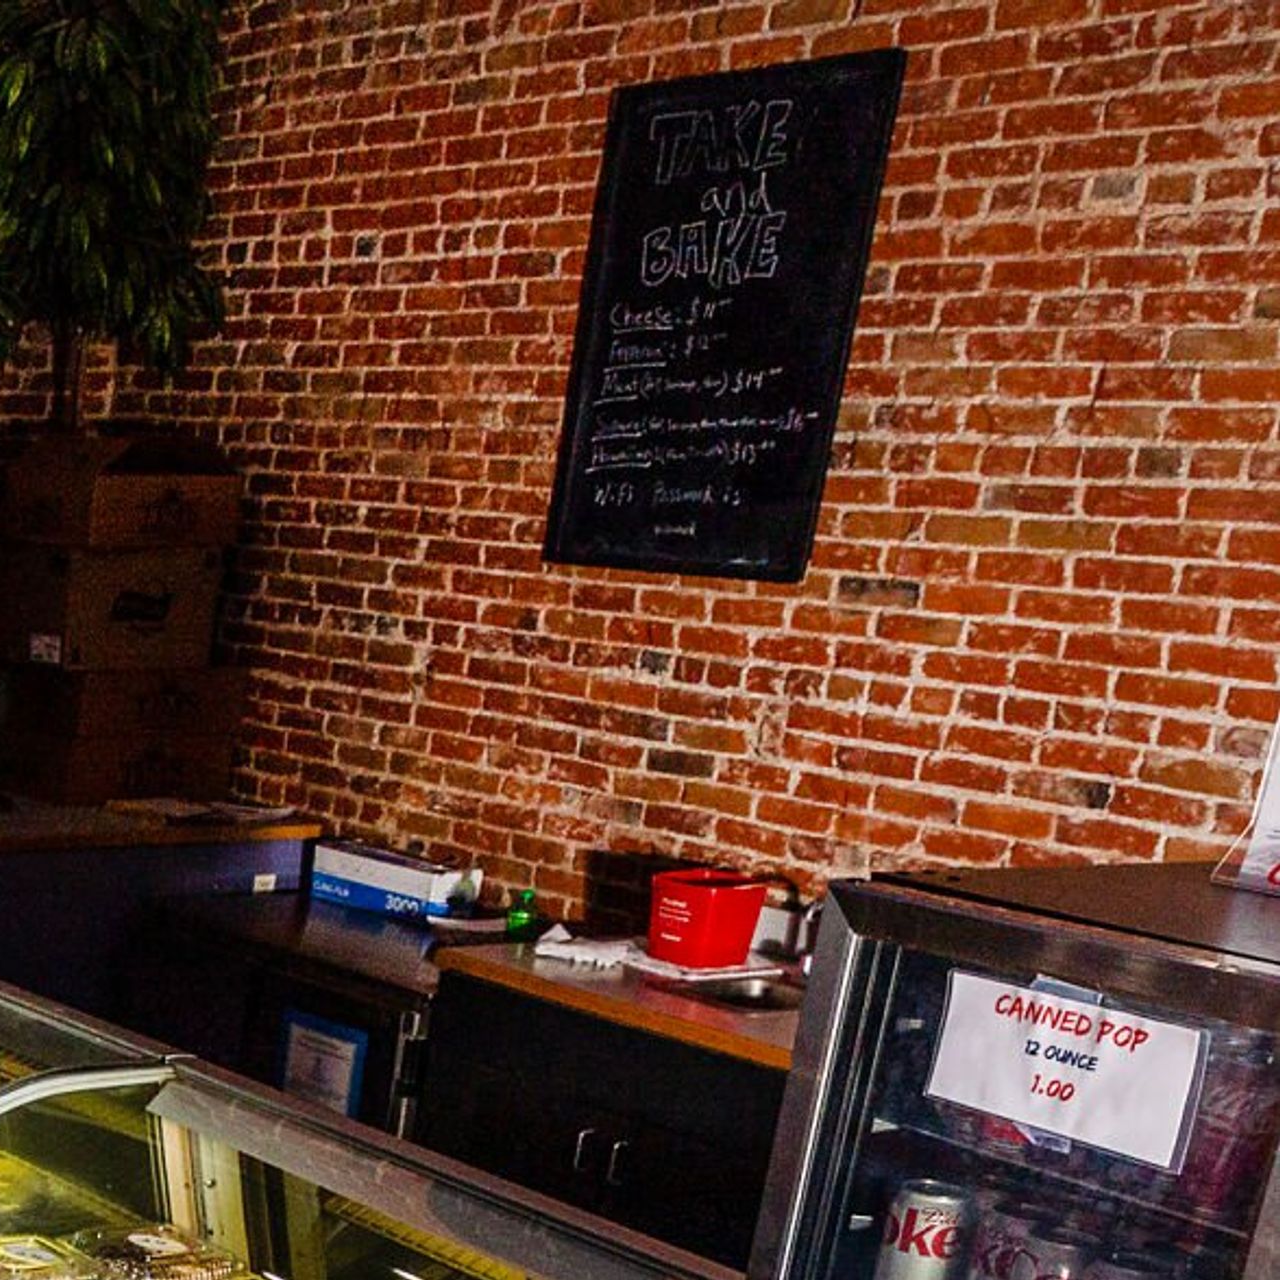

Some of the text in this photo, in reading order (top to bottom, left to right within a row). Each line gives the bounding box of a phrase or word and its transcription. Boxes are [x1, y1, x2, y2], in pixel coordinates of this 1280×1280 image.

[650, 99, 793, 184] TAKE
[700, 172, 773, 216] and
[642, 211, 787, 286] BAKE
[994, 993, 1150, 1053] CANNED POP
[1024, 1039, 1099, 1072] 12 OUNCE
[1030, 1073, 1076, 1103] 1.00
